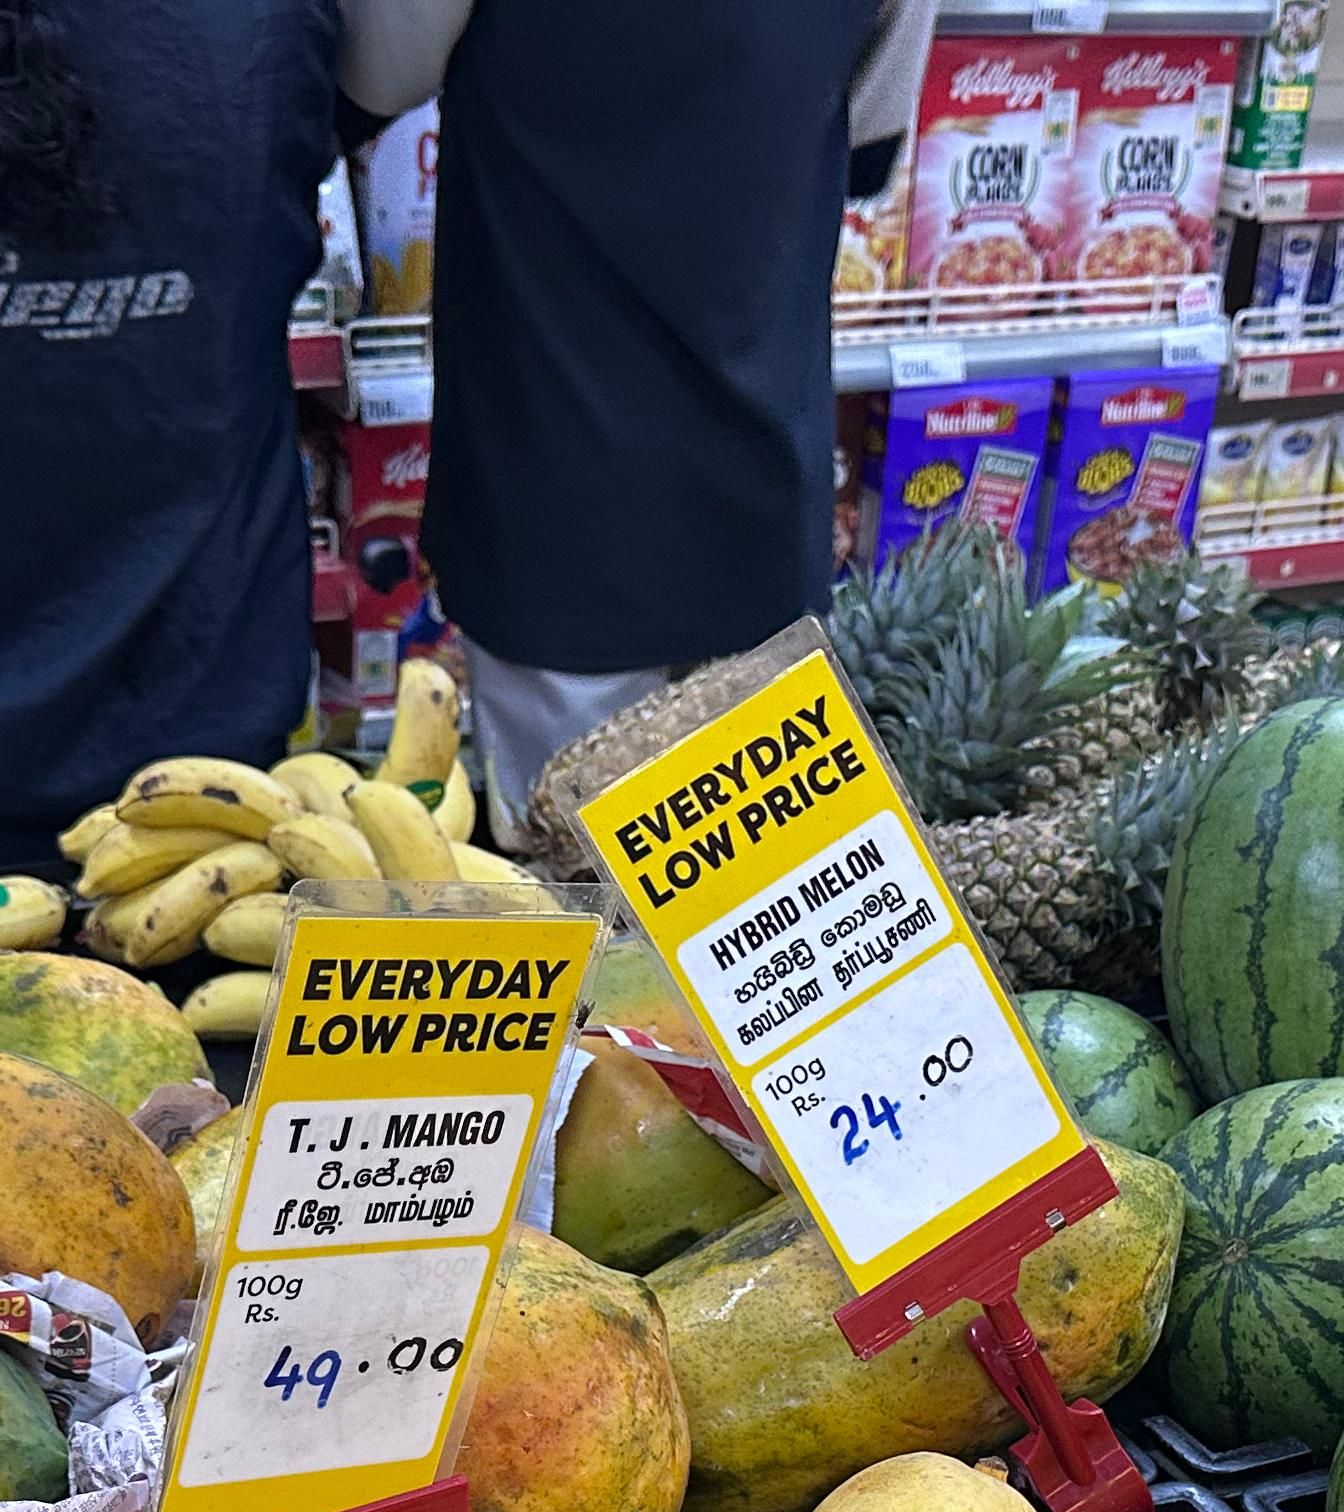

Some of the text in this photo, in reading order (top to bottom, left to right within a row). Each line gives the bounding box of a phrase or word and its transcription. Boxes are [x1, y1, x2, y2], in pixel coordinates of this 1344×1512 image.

[614, 695, 837, 865] EVERYDAY
[637, 739, 867, 910] LOW PRICE
[709, 839, 885, 972] HYBRID MELON
[302, 957, 570, 1002] EVERYDAY
[286, 1012, 556, 1056] LOW PRICE
[764, 1055, 827, 1103] 100g
[792, 1091, 827, 1118] Rs.
[382, 1109, 506, 1148] MANGO
[364, 1190, 474, 1228] மாம்பழம்
[235, 1275, 304, 1302] 100g
[244, 1303, 280, 1325] Rs.
